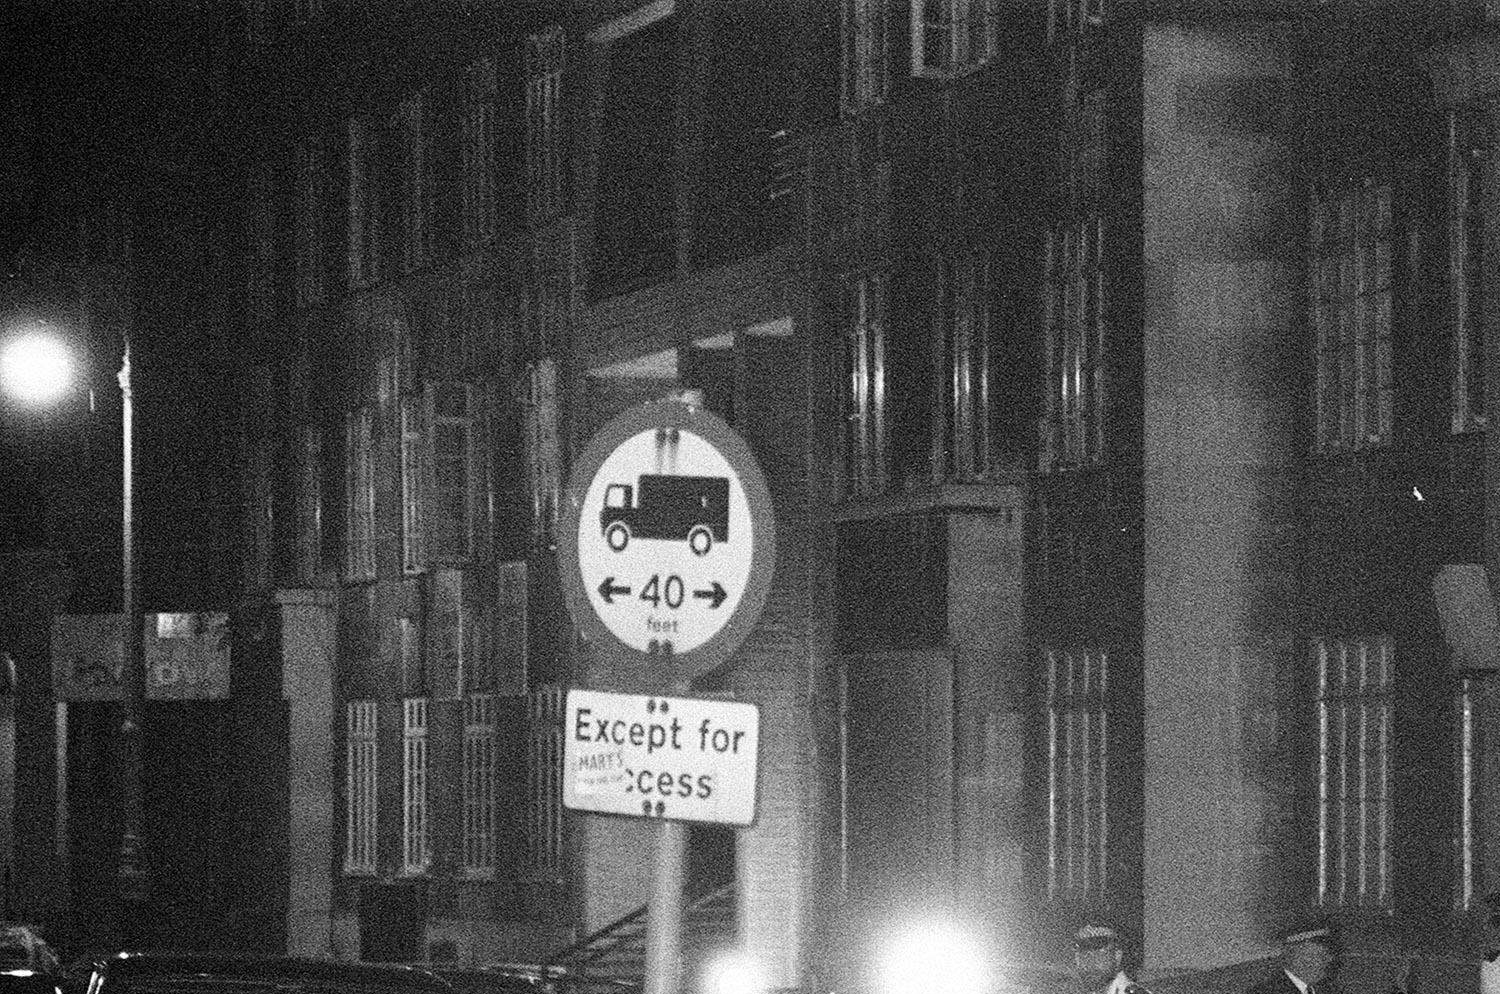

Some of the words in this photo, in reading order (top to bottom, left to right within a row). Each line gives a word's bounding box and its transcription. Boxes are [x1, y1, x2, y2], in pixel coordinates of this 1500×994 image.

[638, 574, 685, 610] 40
[647, 615, 679, 634] feet
[575, 707, 682, 754] Except
[698, 718, 745, 755] for
